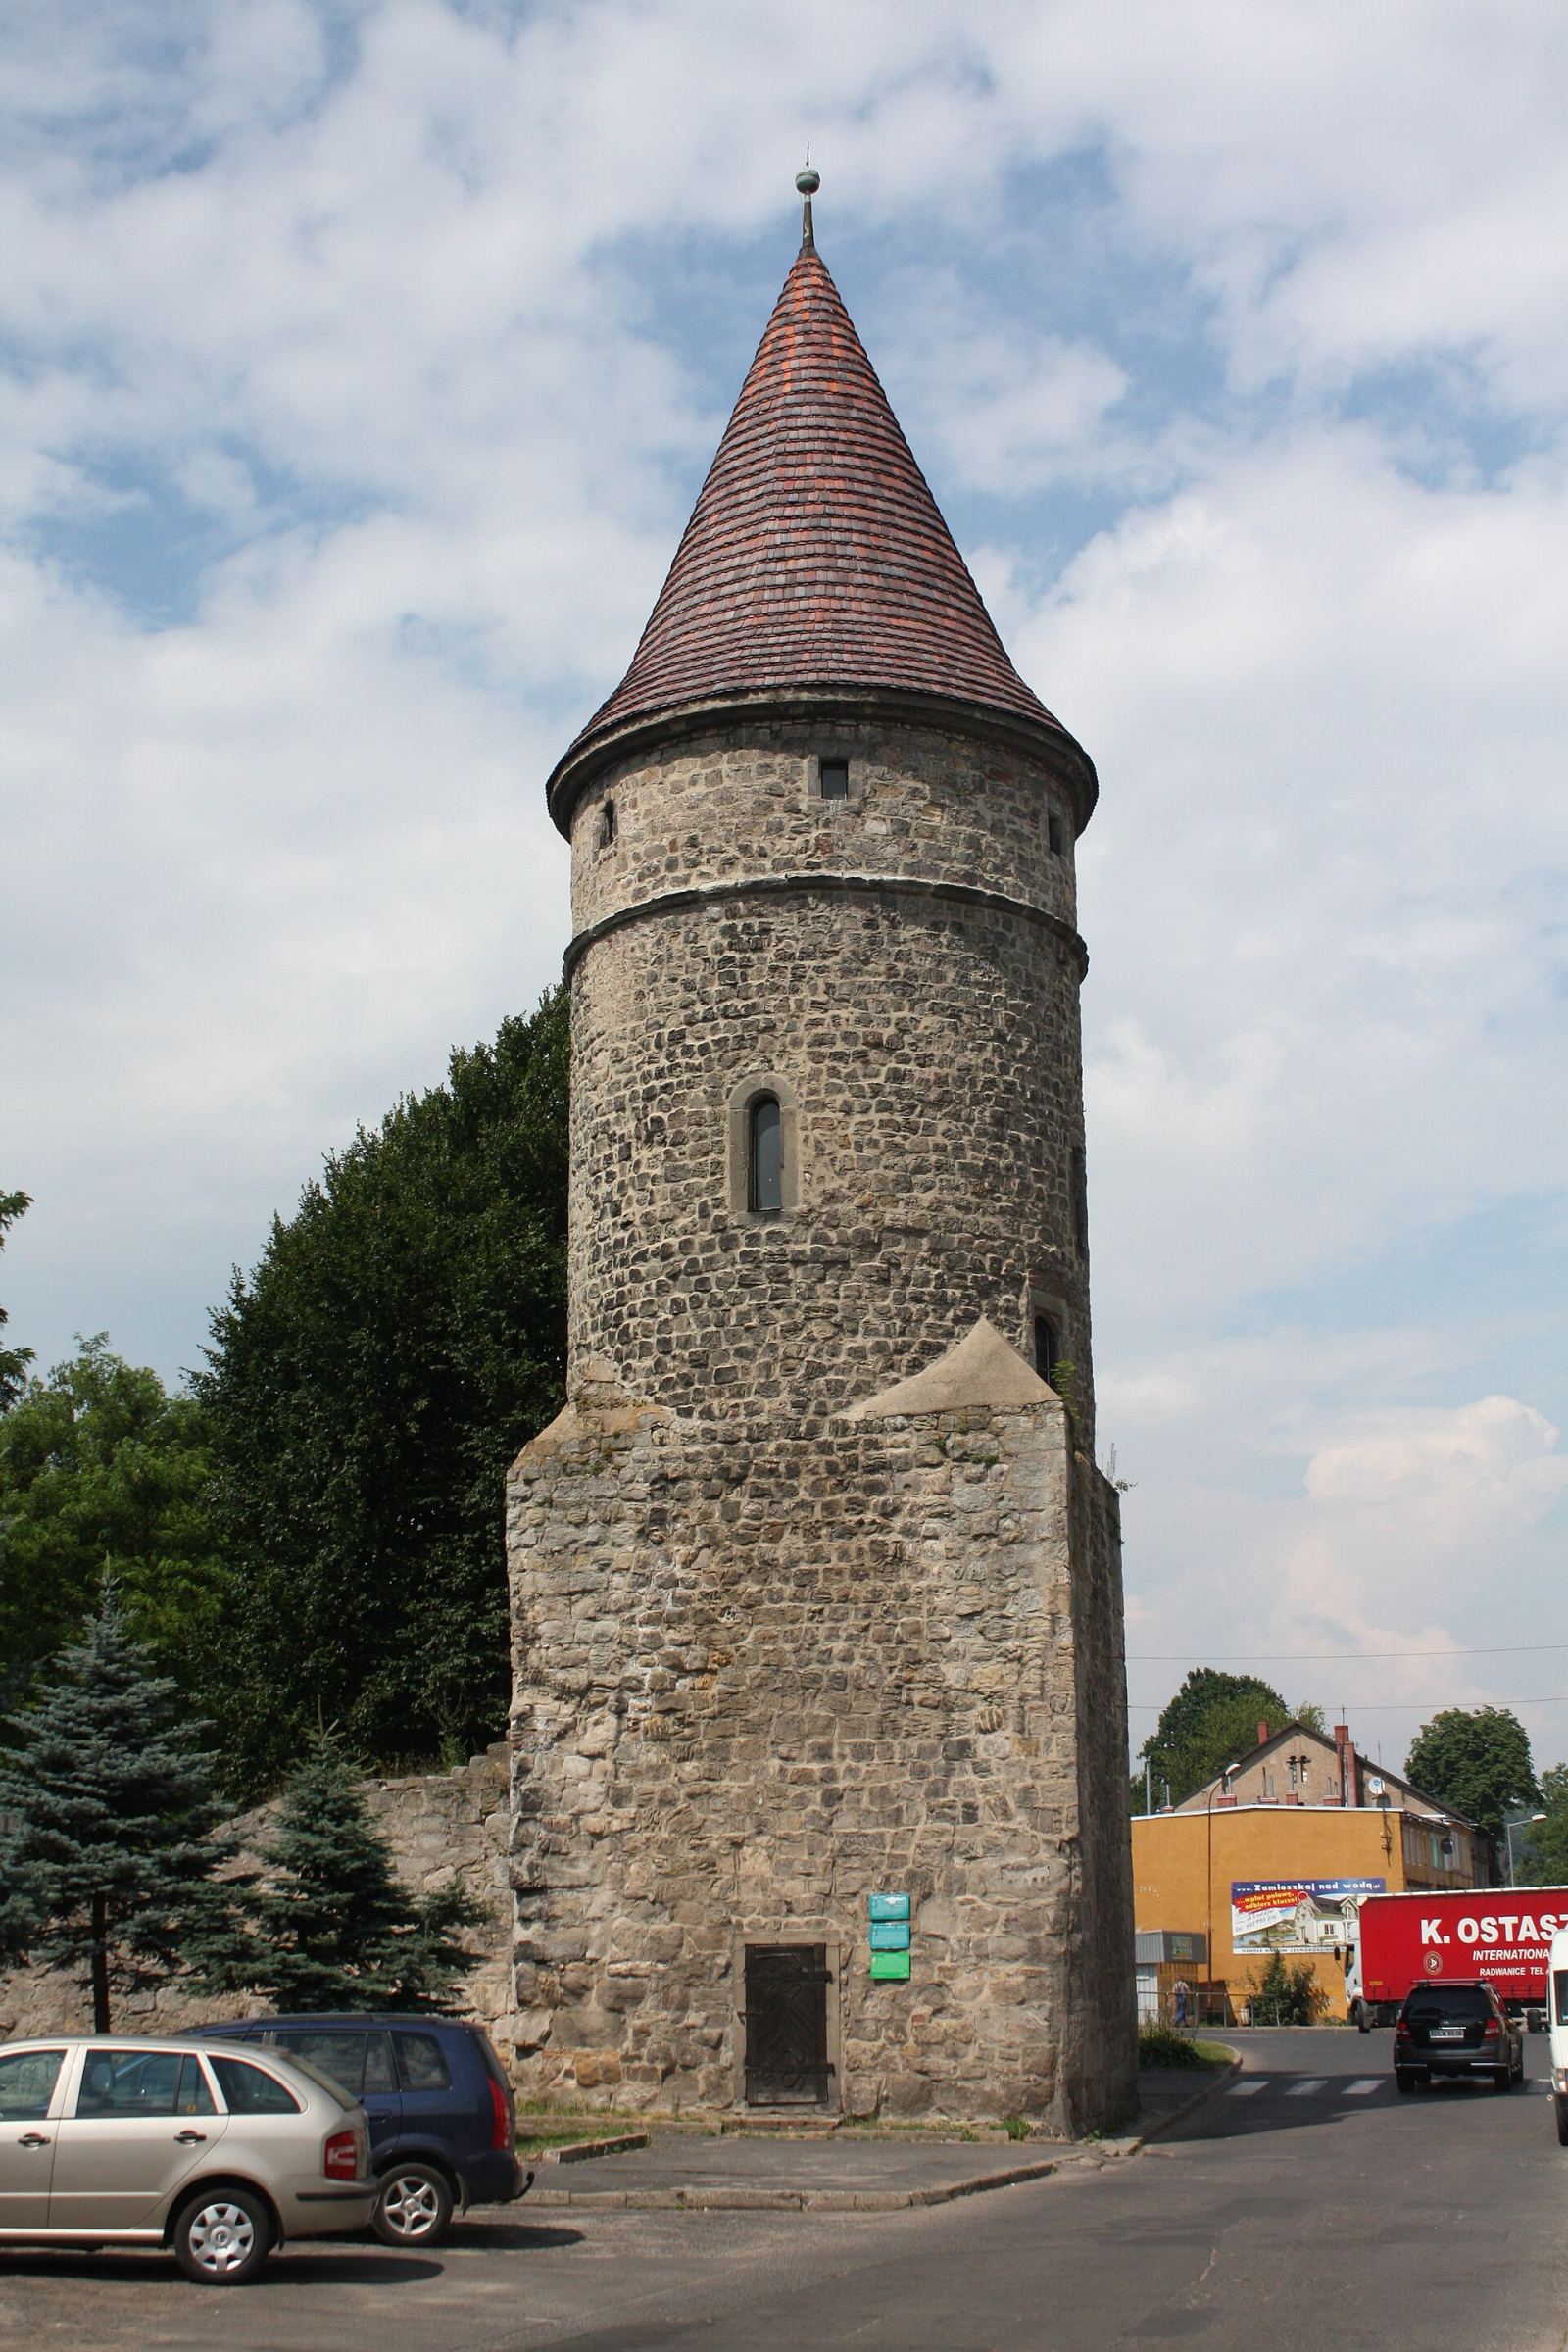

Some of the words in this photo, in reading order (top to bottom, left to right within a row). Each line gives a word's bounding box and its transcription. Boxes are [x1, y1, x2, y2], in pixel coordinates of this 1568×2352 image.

[1318, 1881, 1339, 1890] nad
[1421, 1919, 1450, 1944] K.
[1473, 1949, 1549, 1961] INTERNATIONA
